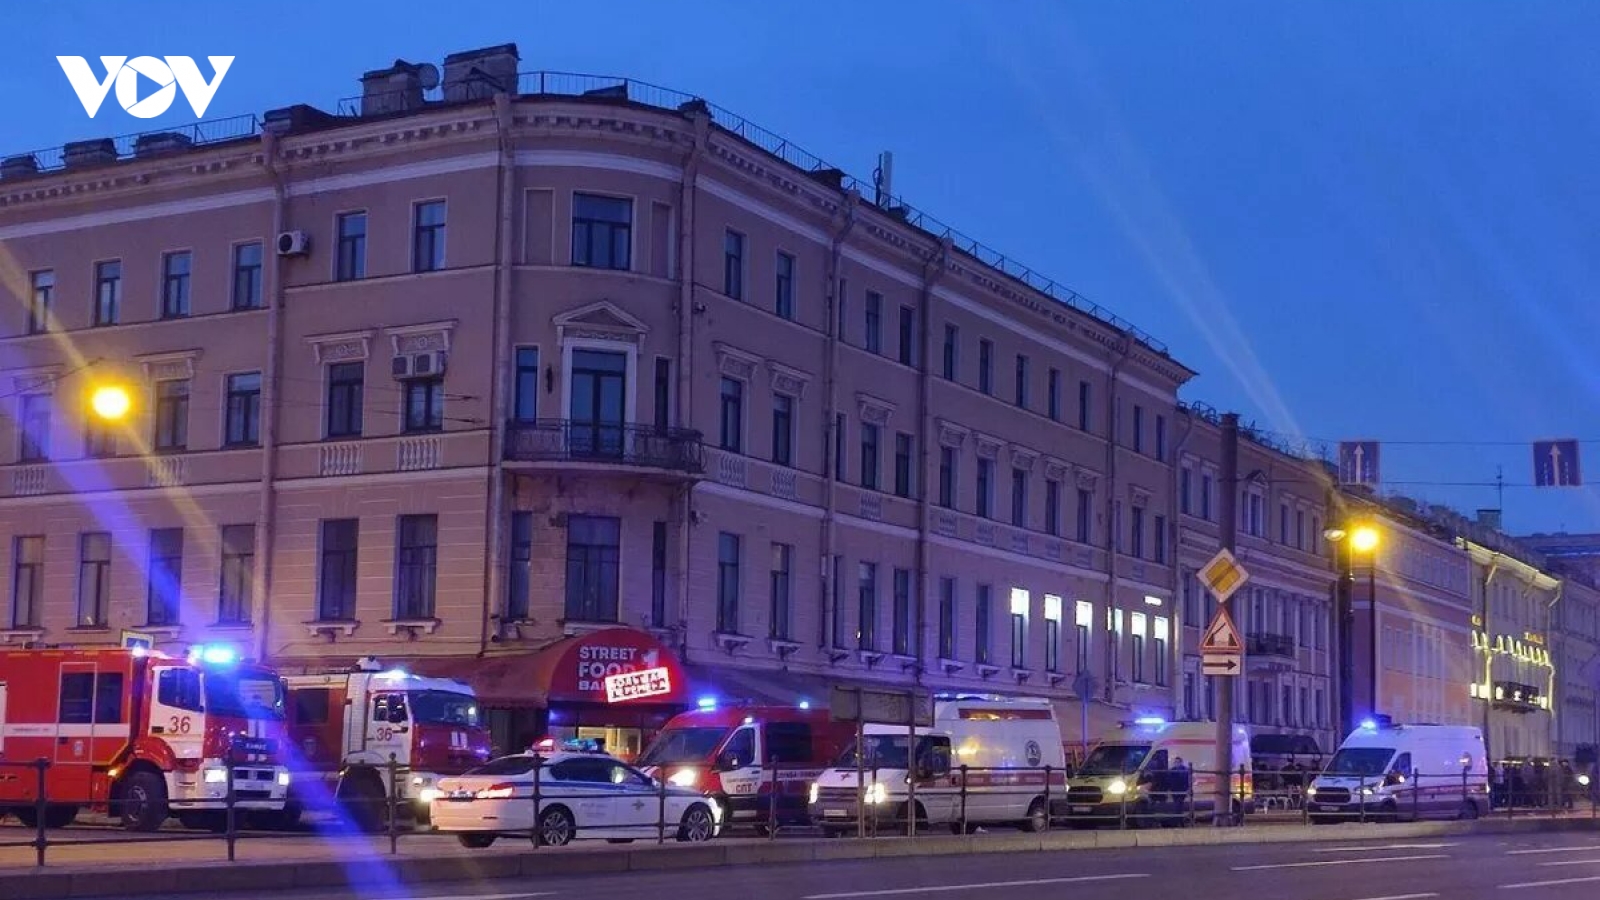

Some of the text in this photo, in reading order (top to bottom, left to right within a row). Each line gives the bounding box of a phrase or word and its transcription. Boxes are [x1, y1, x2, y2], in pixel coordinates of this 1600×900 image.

[579, 645, 638, 661] STREET
[169, 715, 191, 734] 36
[375, 726, 393, 742] 36
